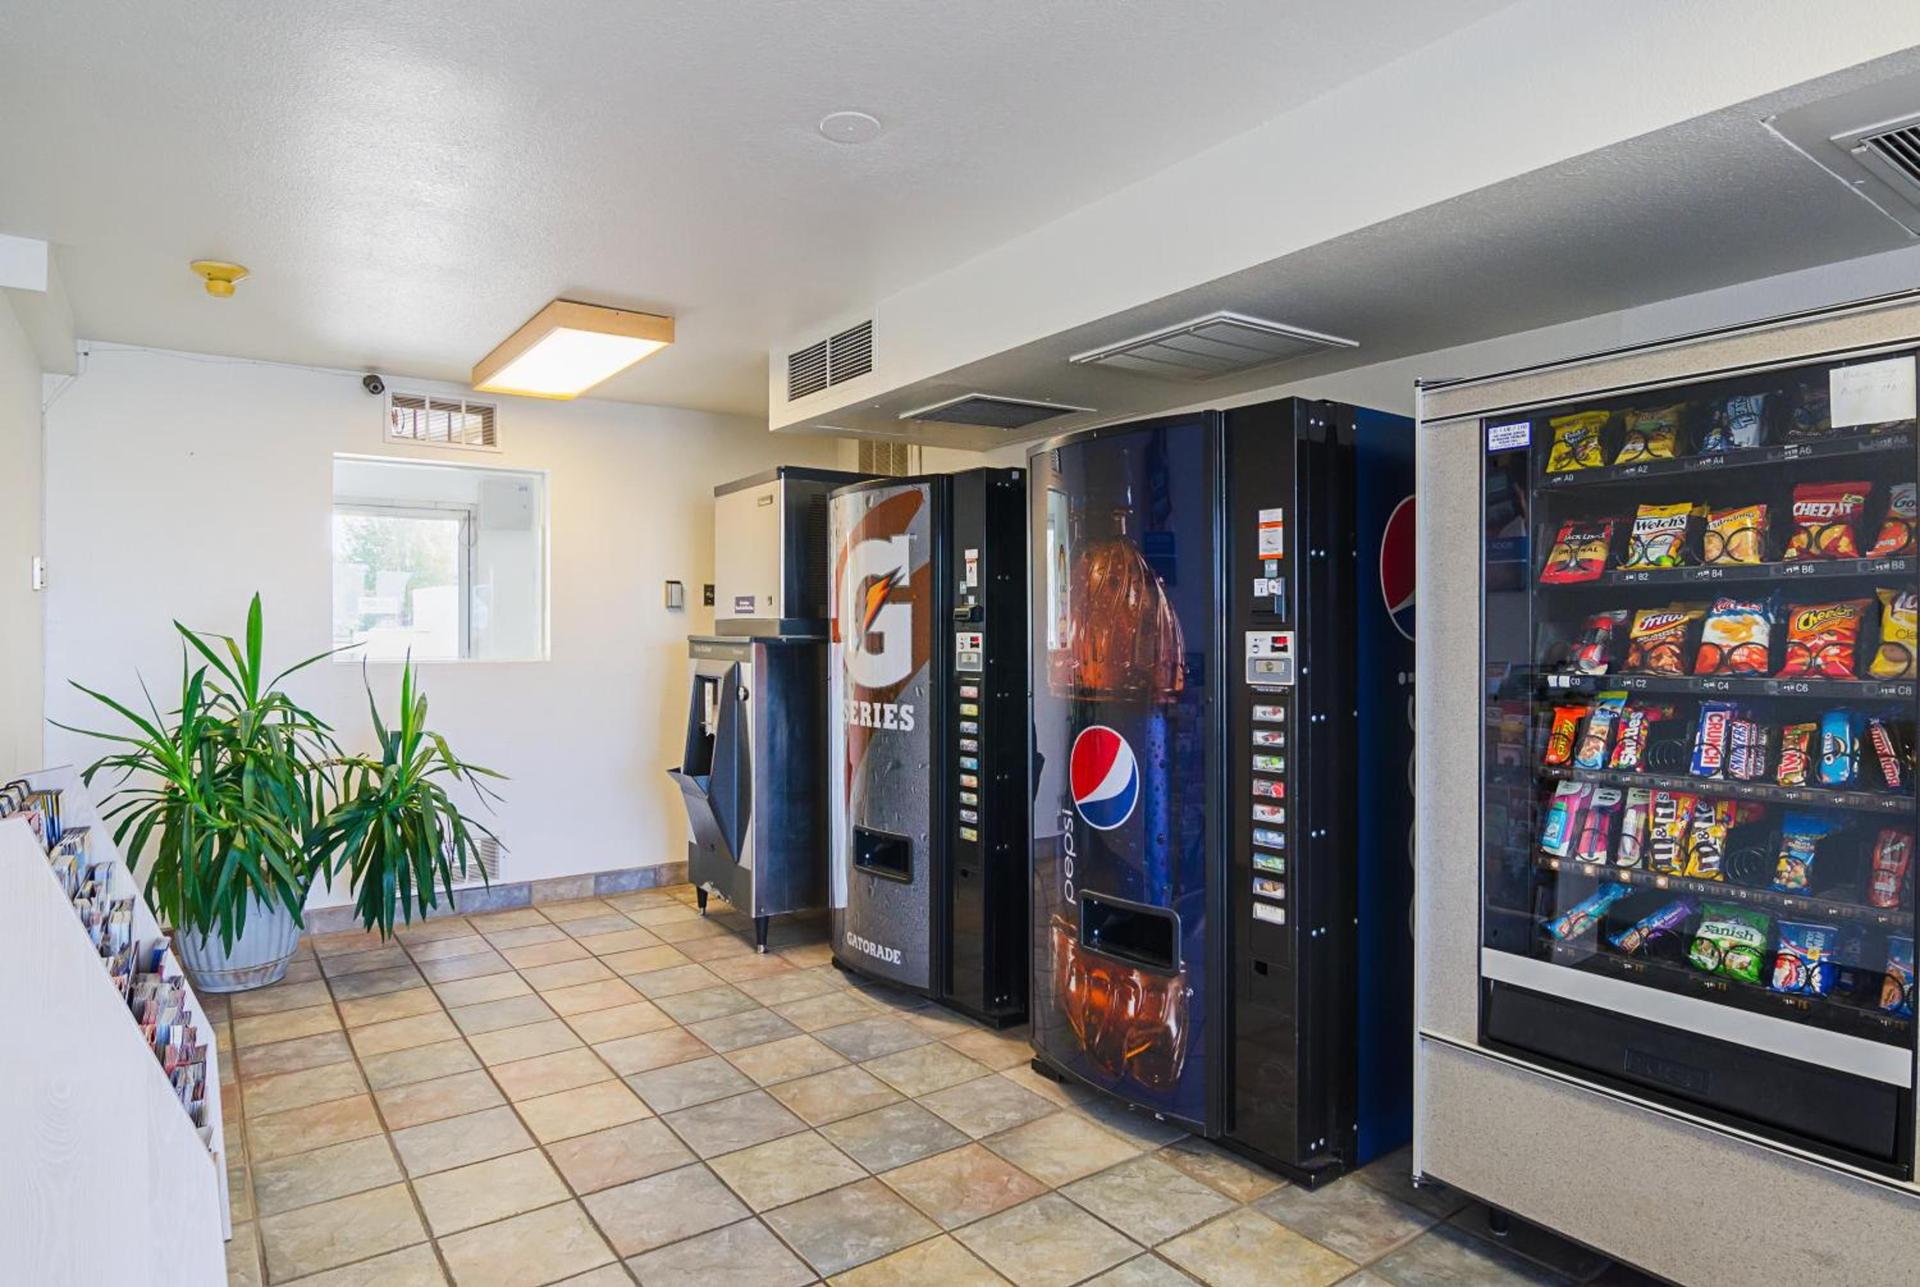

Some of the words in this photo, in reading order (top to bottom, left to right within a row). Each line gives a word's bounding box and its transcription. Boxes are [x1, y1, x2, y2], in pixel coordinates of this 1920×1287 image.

[1799, 446, 1812, 455] A6
[1713, 457, 1724, 465] A4
[1637, 466, 1648, 474] A2
[1635, 516, 1685, 531] Welch's
[1558, 546, 1599, 555] ORINAL
[1801, 565, 1814, 574] B6
[1891, 560, 1905, 570] B8
[1712, 569, 1723, 578] B4
[838, 533, 912, 688] G
[1636, 680, 1647, 688] C2
[1718, 682, 1729, 690] C4
[1796, 684, 1808, 692] C6
[1898, 686, 1912, 695] C8
[1062, 808, 1077, 905] pepsi
[847, 931, 901, 965] GATORADE
